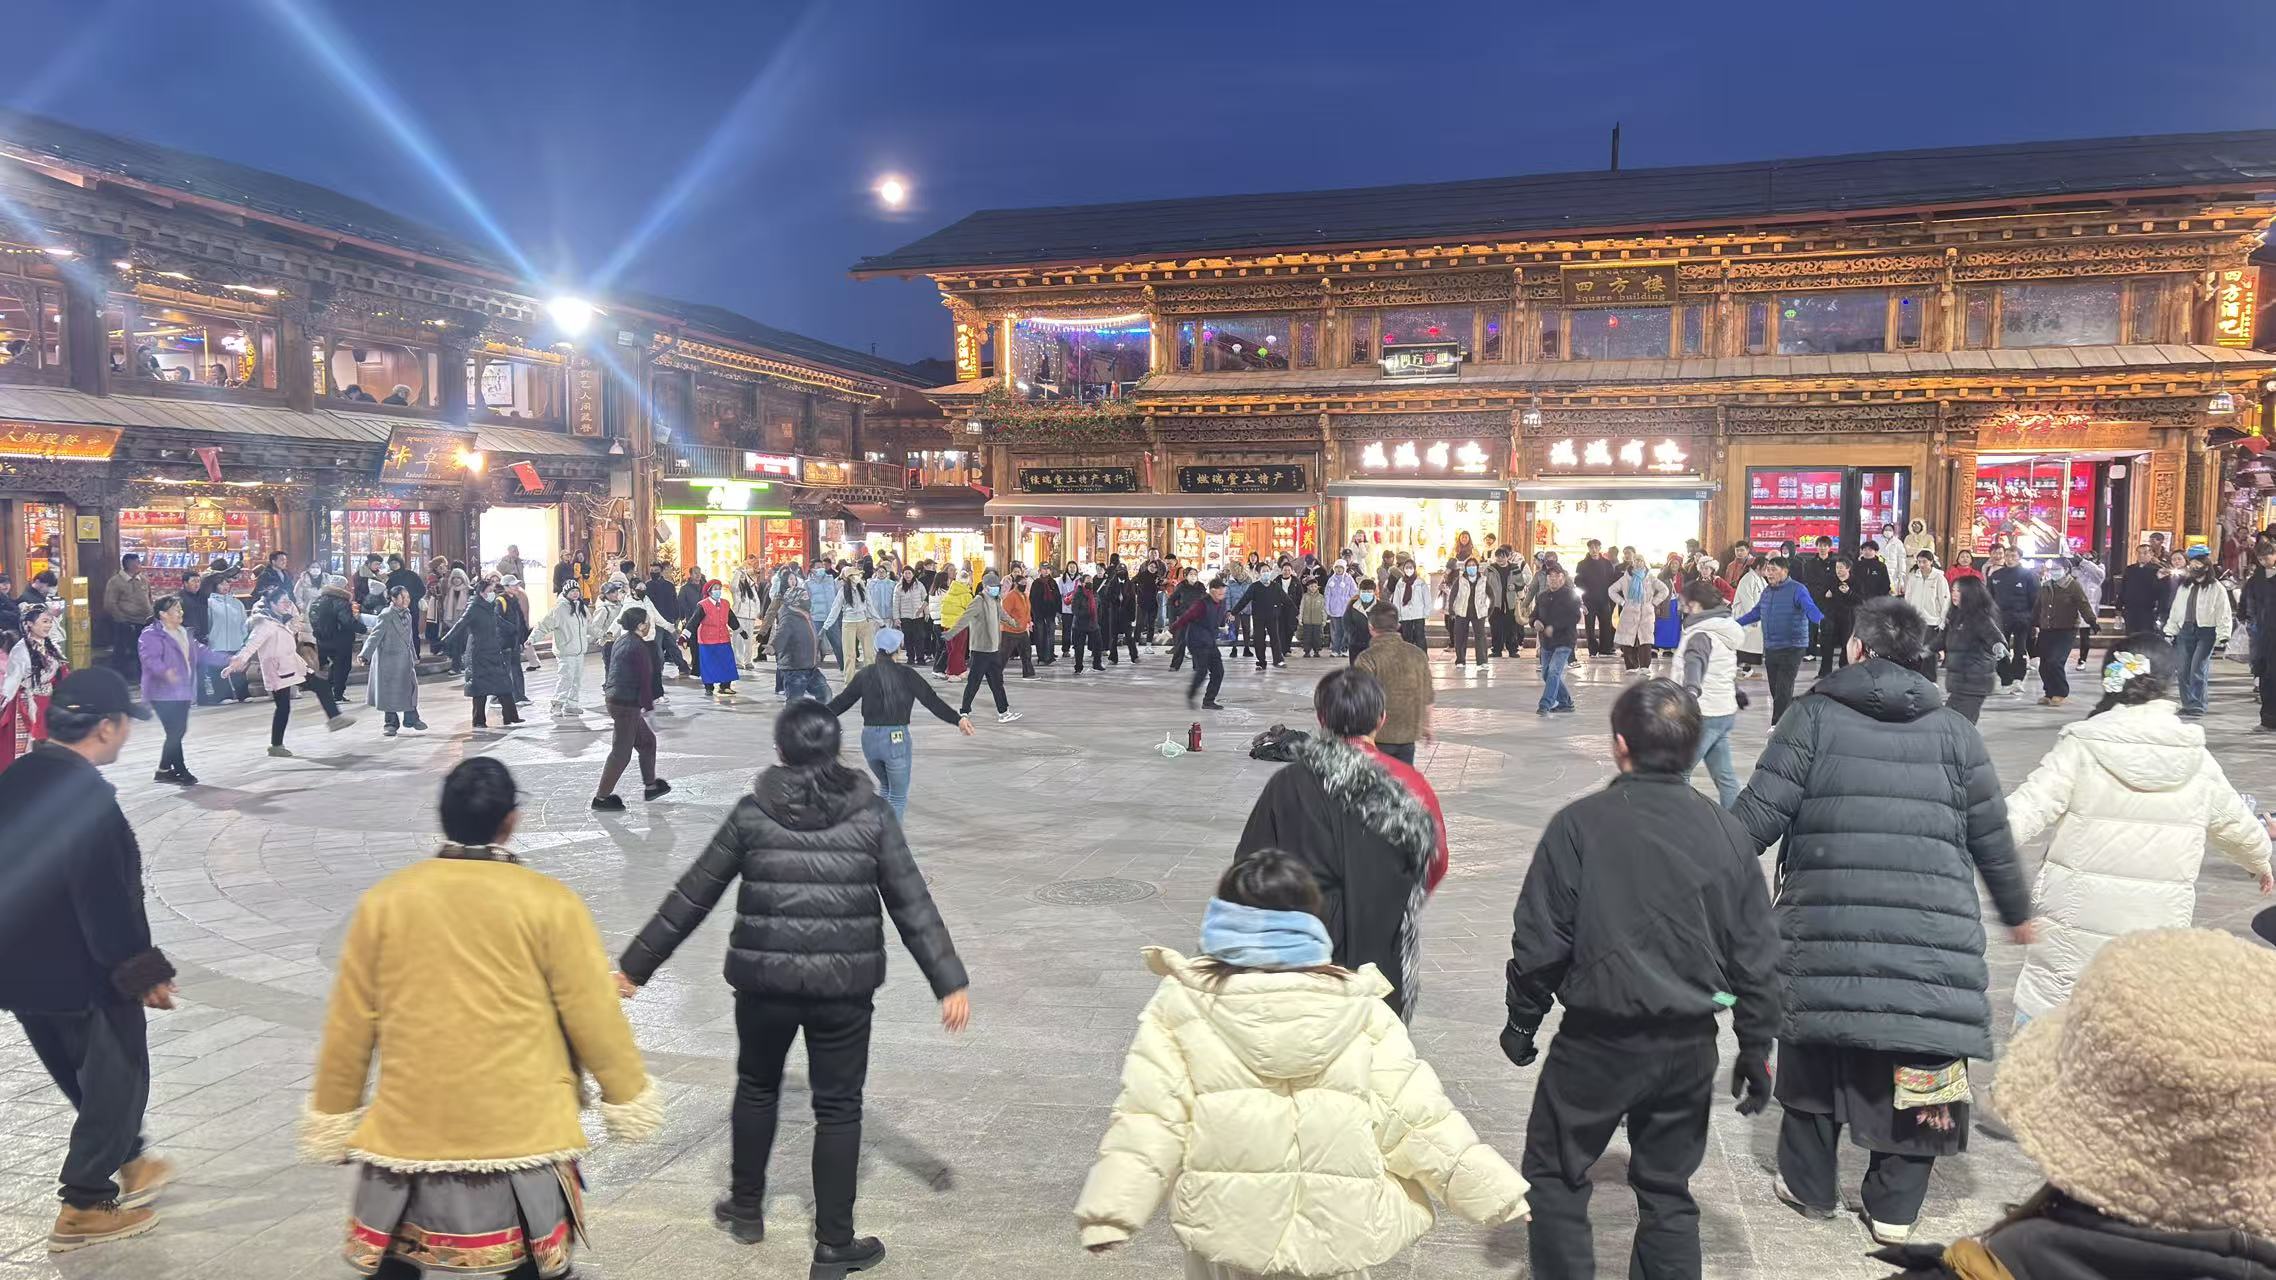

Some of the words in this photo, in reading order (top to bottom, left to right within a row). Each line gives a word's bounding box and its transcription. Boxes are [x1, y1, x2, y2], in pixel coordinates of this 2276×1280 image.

[1575, 275, 1667, 293] 四方楼
[1575, 295, 1613, 303] Square
[1619, 292, 1666, 301] building
[2217, 270, 2243, 335] 四方酒吧
[188, 538, 227, 552] 卡卓刀
